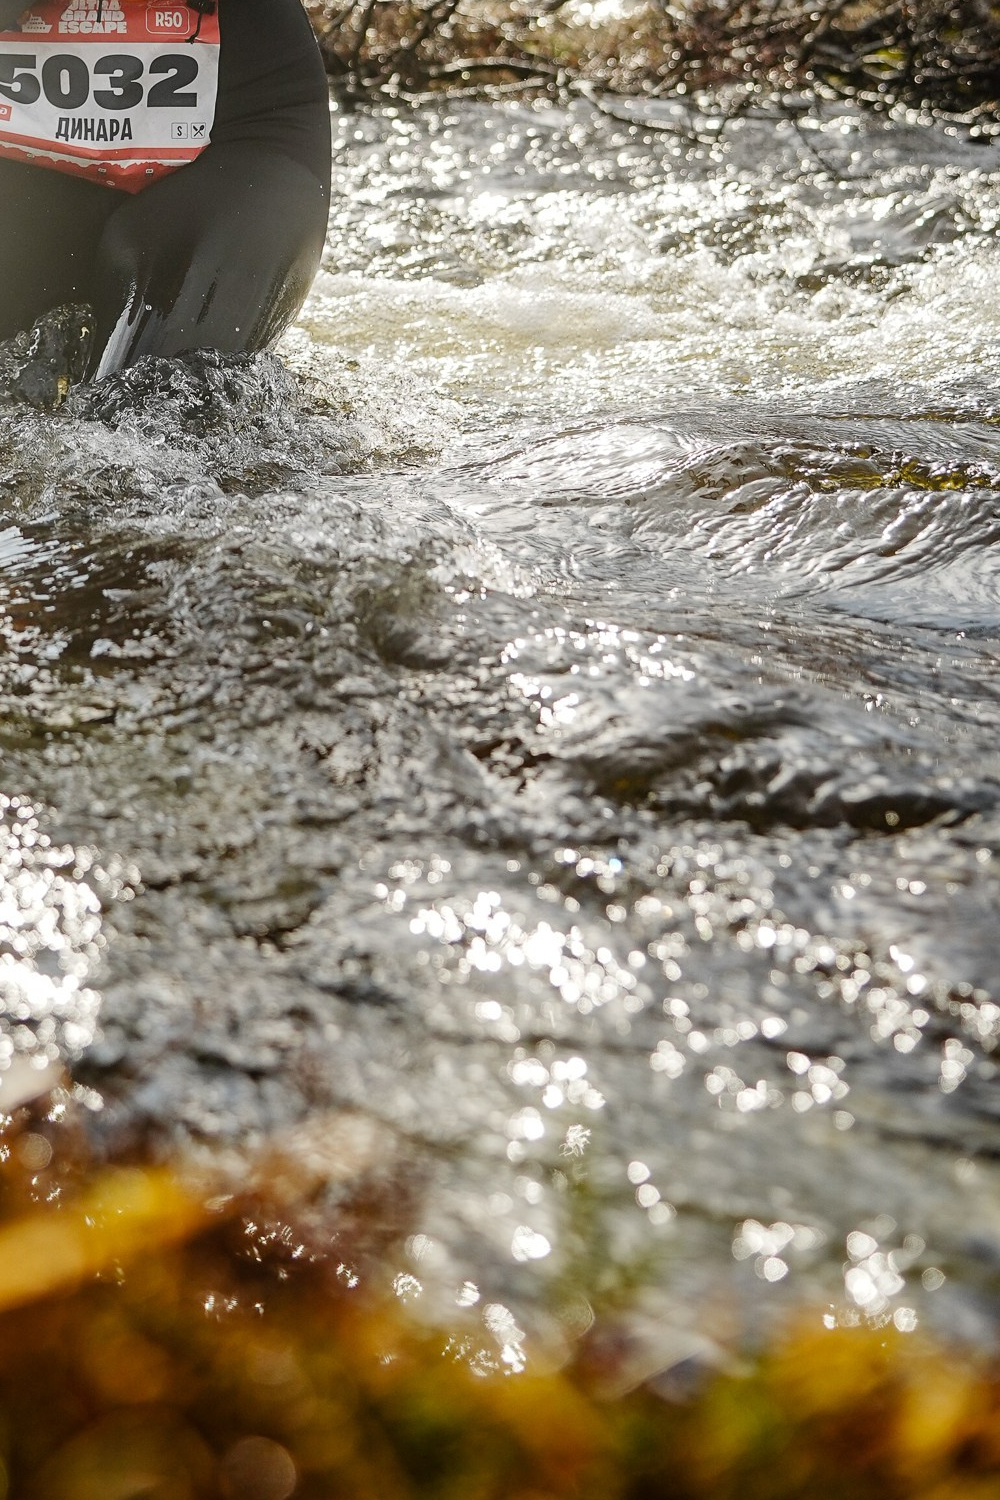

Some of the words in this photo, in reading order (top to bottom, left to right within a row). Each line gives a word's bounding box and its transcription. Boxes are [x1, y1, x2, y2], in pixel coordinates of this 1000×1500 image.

[69, 0, 121, 11] ULTRA
[60, 10, 125, 22] GRAND
[155, 11, 183, 28] R50
[58, 21, 128, 34] ESCAPE
[55, 117, 133, 142] ДИНАРА
[176, 126, 183, 137] S
